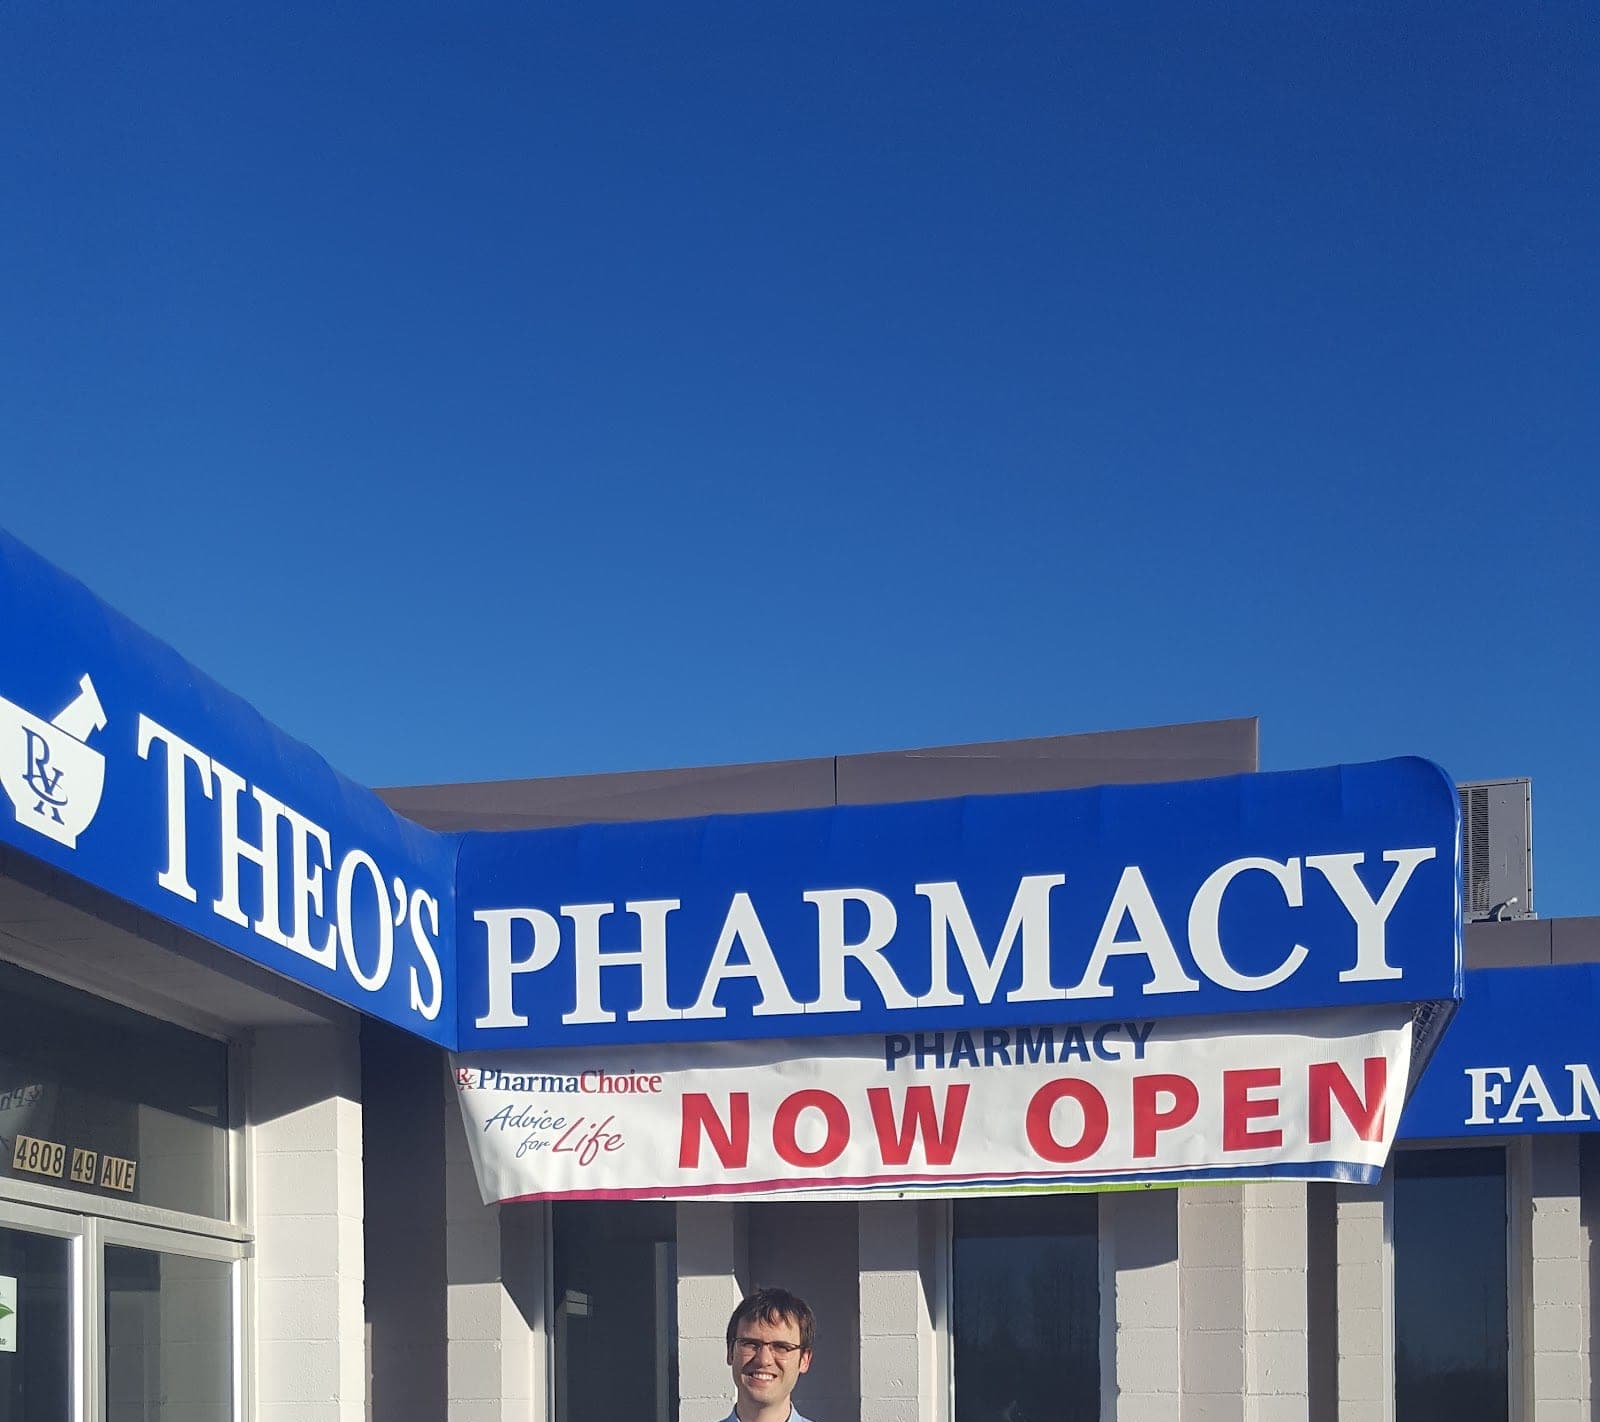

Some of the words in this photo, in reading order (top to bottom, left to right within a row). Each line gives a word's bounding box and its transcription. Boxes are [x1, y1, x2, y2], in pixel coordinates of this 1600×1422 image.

[136, 712, 443, 1021] THEO'S
[473, 847, 1436, 1029] PHARMACY
[884, 1022, 1156, 1071] PHARMACY
[477, 1068, 663, 1094] PharmaChoice
[484, 1104, 567, 1132] Advice
[679, 1083, 971, 1169] NOW
[1026, 1056, 1387, 1163] OPEN
[16, 1139, 63, 1174] 4808
[73, 1151, 95, 1181] 49
[102, 1158, 135, 1189] AVE
[515, 1132, 551, 1158] for
[552, 1115, 625, 1166] Life
